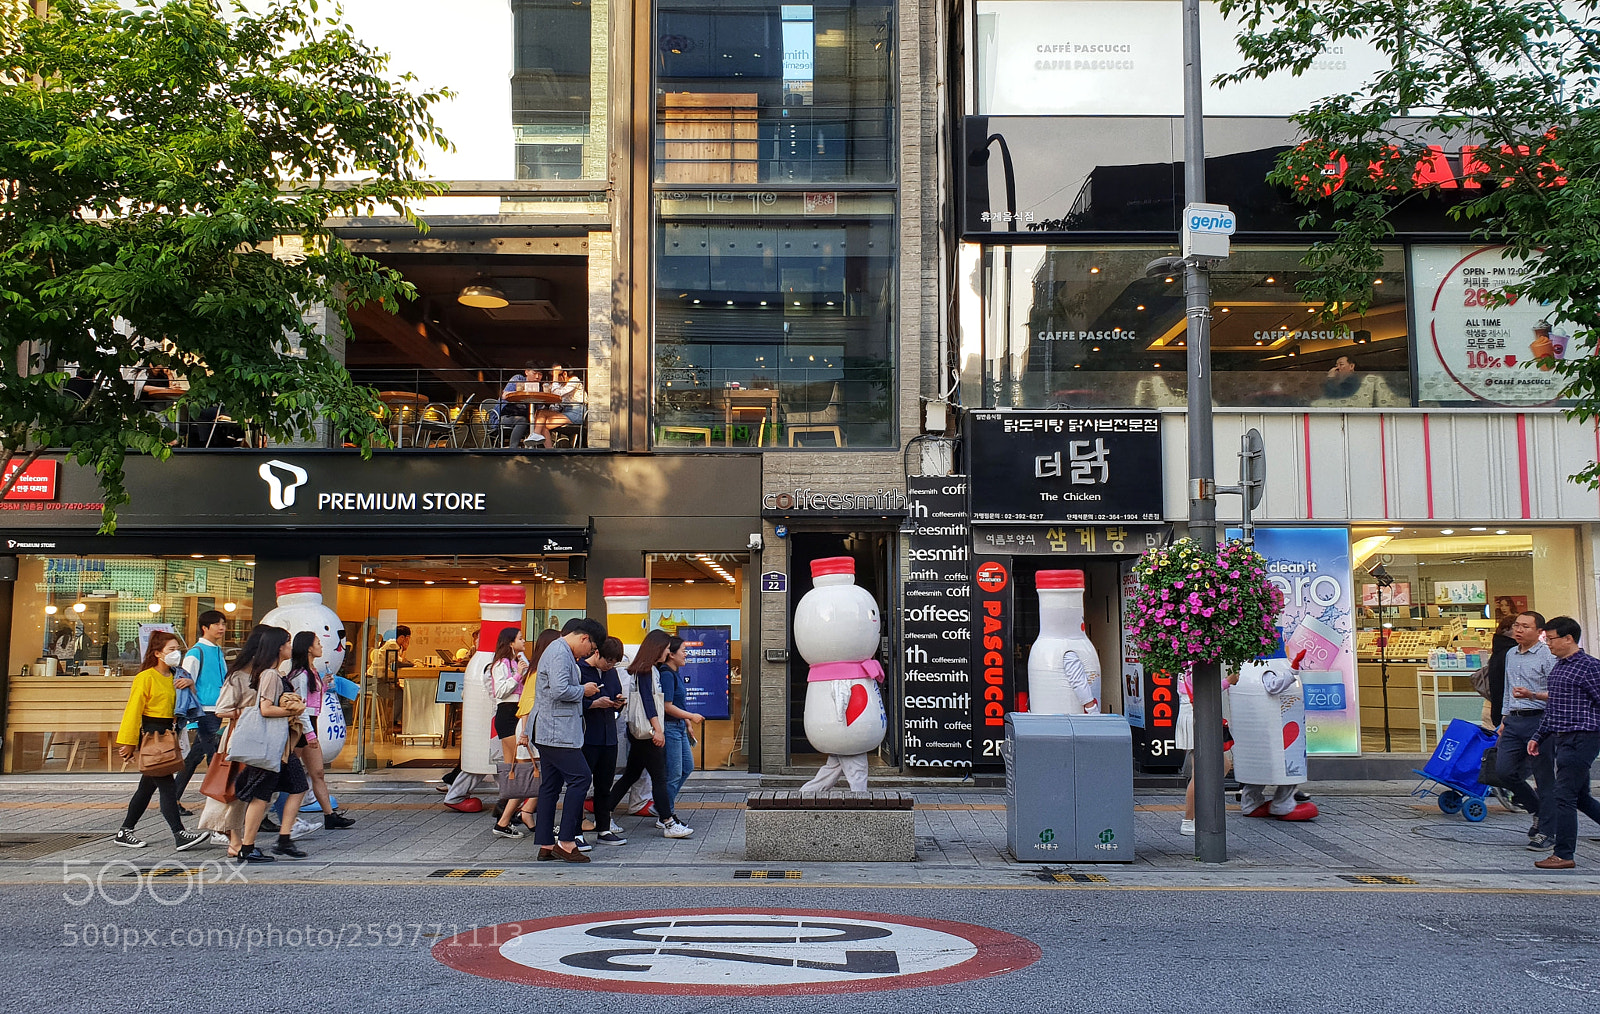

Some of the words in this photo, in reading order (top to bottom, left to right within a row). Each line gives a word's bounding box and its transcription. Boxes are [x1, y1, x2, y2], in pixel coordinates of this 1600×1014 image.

[1037, 42, 1071, 53] CAFFÉ
[1074, 44, 1131, 53] PASCUCCI
[980, 211, 1034, 222] 휴게음식점
[1191, 214, 1233, 230] genie
[1463, 268, 1485, 276] OPEN
[1463, 277, 1490, 288] 커피류
[1465, 319, 1480, 327] ALL
[1482, 319, 1501, 327] TIME
[1466, 338, 1506, 349] 모든음료
[1466, 350, 1502, 369] 10%
[1003, 419, 1064, 433] 닭도리탕
[1068, 419, 1159, 433] 닭샤브전문점
[1035, 451, 1062, 478] 더
[1069, 438, 1110, 485] 닭
[20, 474, 48, 482] telecom
[318, 493, 416, 510] PREMIUM
[422, 493, 486, 510] STORE
[762, 488, 910, 511] coffeesmith
[1040, 493, 1059, 501] The
[1063, 493, 1101, 501] Chicken
[1269, 561, 1305, 573] clean
[1307, 561, 1317, 572] it
[768, 581, 780, 590] 22
[1265, 575, 1341, 607] ero
[906, 589, 942, 597] coffeesmith
[931, 656, 968, 664] coffeesmith
[983, 600, 1005, 726] PASCUCCI
[1308, 693, 1341, 706] zero
[925, 739, 962, 748] coffeesmith
[1151, 739, 1176, 757] 3F
[1033, 843, 1059, 851] 서대문구
[1094, 843, 1119, 851] 서대문구
